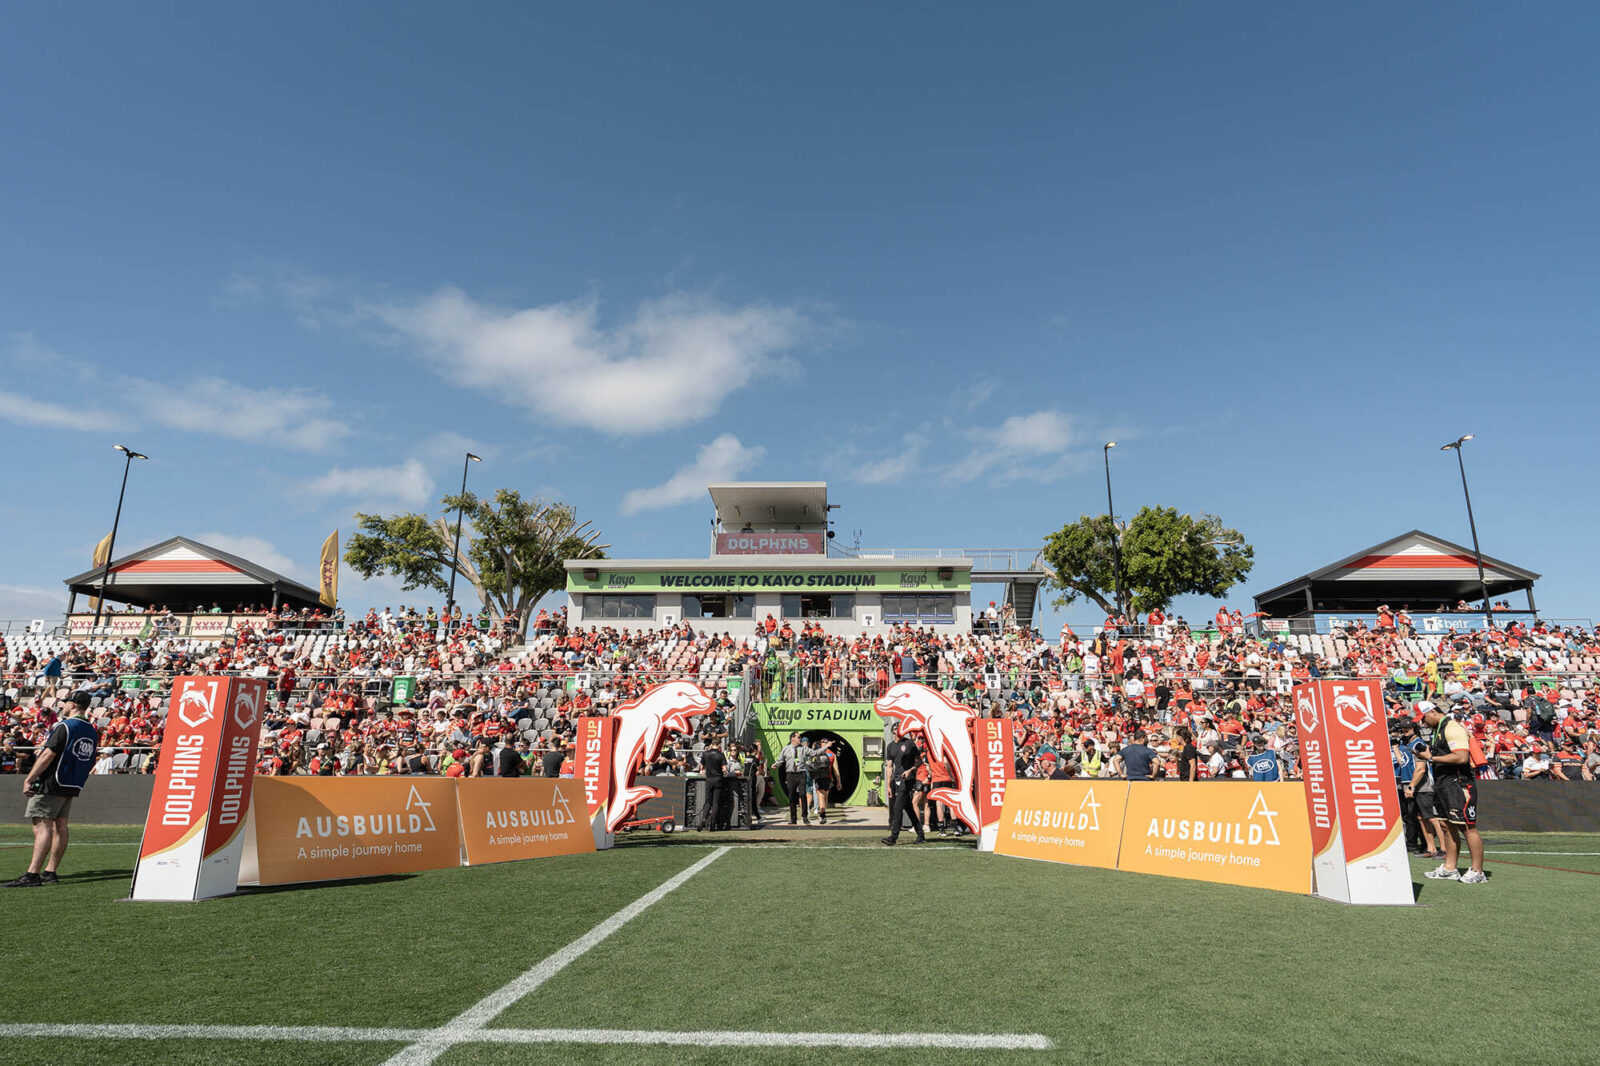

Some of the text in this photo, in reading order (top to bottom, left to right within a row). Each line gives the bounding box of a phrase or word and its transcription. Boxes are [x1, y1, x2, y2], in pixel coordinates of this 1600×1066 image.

[728, 538, 809, 550] DOLPHINS
[323, 560, 334, 588] XXXX
[609, 574, 636, 588] Kayo
[660, 574, 876, 587] WELCOME TO KAYO STADIUM
[900, 573, 928, 588] Kayo
[113, 621, 142, 630] XXXX
[195, 621, 223, 630] XXXX
[990, 680, 995, 688] 5
[770, 706, 872, 725] Kayo STADIUM
[162, 734, 204, 826] DOLPHINS
[219, 736, 250, 825] DOLPHINS
[1305, 739, 1330, 829] DOLPHINS
[1345, 739, 1387, 830] DOLPHINS
[296, 814, 422, 839] AUSBUILD
[486, 809, 565, 829] AUSBUILD
[1013, 809, 1089, 831] AUSBUILD
[489, 831, 569, 845] A simple journey home
[1011, 831, 1085, 848] A simple journey home
[1147, 818, 1263, 845] AUSBUILD
[297, 841, 423, 860] A simple journey home
[1145, 844, 1261, 867] A simple journey home
